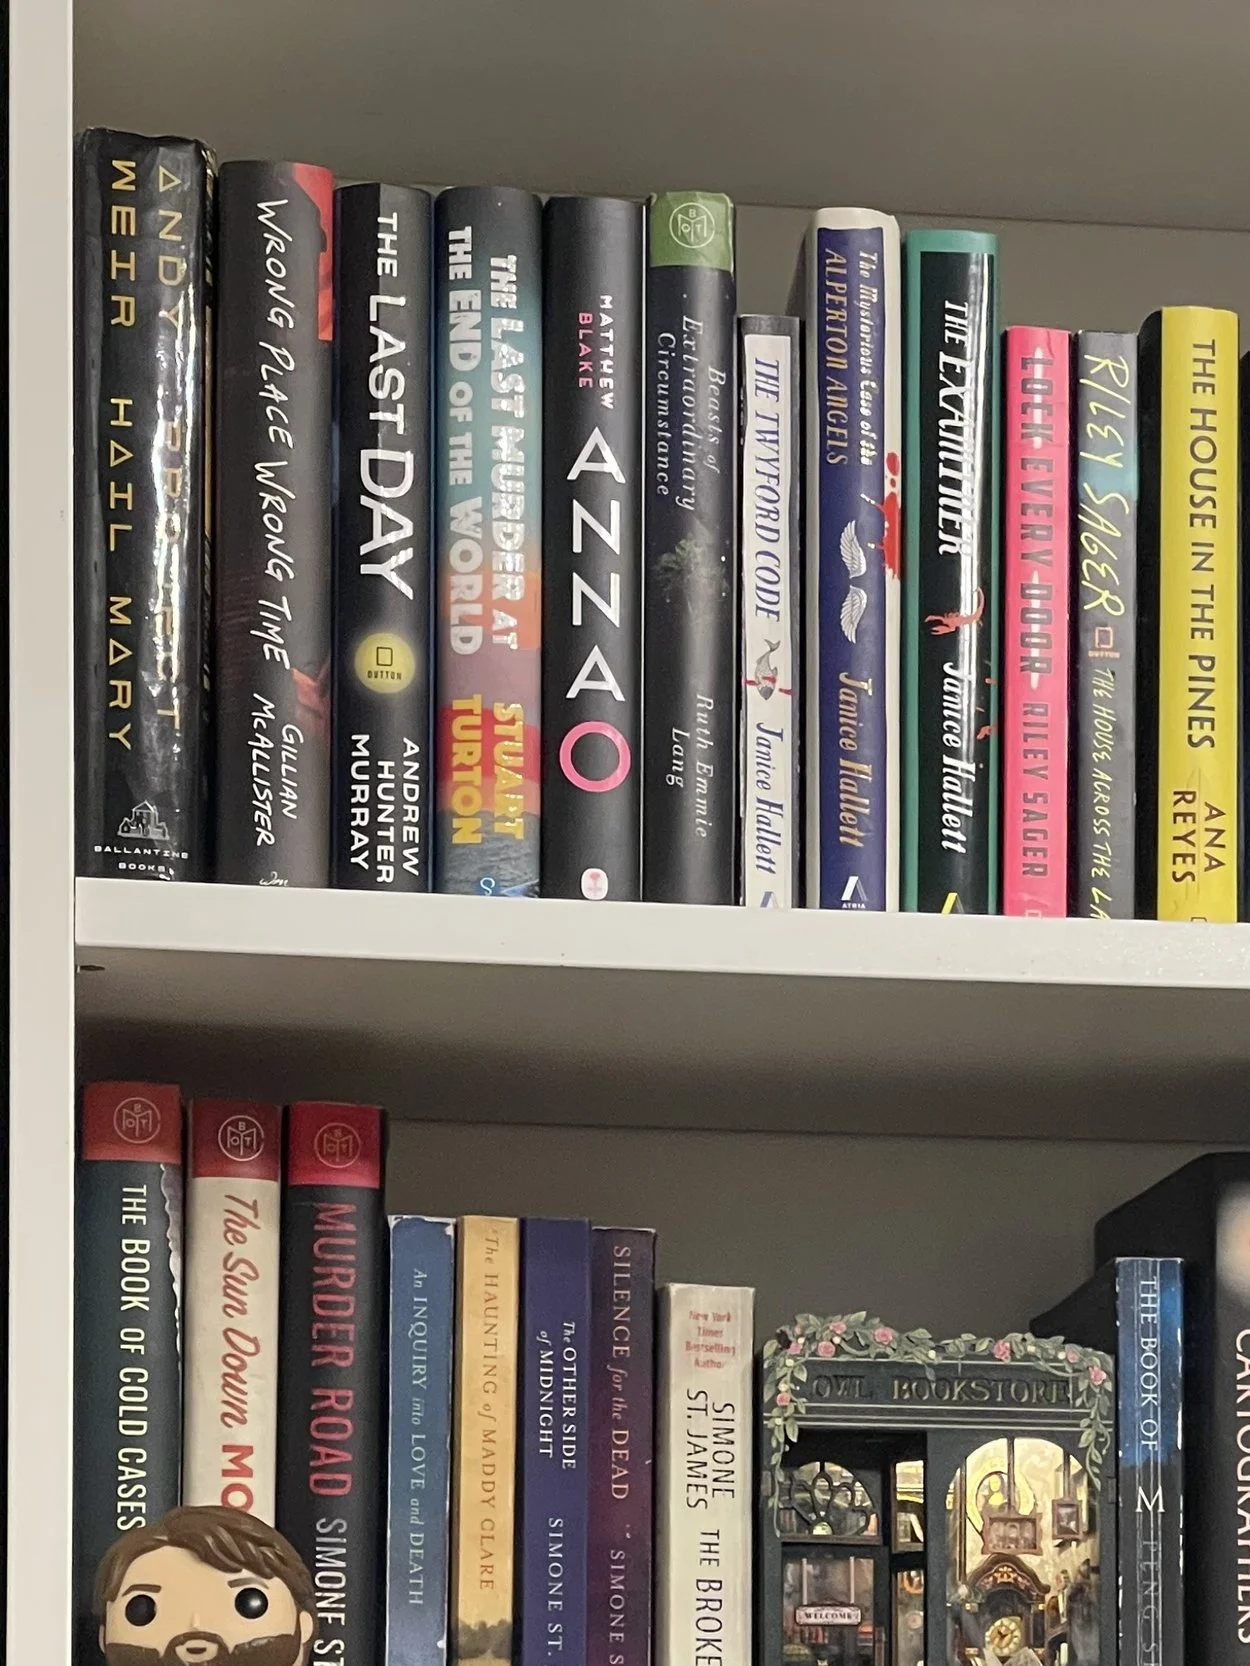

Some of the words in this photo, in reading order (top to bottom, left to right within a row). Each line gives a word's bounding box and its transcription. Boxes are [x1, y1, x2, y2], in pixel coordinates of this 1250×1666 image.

[110, 160, 137, 328] WEIR
[257, 199, 294, 329] WRONG
[377, 212, 397, 276] THE
[257, 342, 294, 449] PLACE
[369, 294, 406, 442] LAST
[657, 331, 676, 495] Circumstance
[676, 315, 703, 511] Extraordinary
[1193, 340, 1215, 395] THE
[110, 397, 134, 551] HAIL
[1190, 408, 1217, 529] HOUSE
[252, 460, 295, 582] WRONG
[359, 447, 413, 601] DAY
[1191, 543, 1214, 572] IN
[251, 592, 291, 669] TIME
[1191, 586, 1214, 641] THE
[109, 596, 132, 752] MARY
[1187, 656, 1216, 748] PINES
[351, 732, 370, 871] MURRAY
[377, 759, 393, 884] HUNTER
[402, 737, 420, 876] ANDREW
[1172, 791, 1196, 883] REYES
[1204, 801, 1226, 873] ANA
[122, 1184, 146, 1226] THE
[222, 1194, 260, 1246] The
[121, 1239, 150, 1311] BOOK
[222, 1251, 260, 1319] Sun
[311, 1203, 357, 1369] MURDER
[121, 1328, 145, 1355] OF
[220, 1328, 260, 1428] Down
[118, 1367, 148, 1437] COLD
[687, 1389, 708, 1421] ST.
[811, 1374, 871, 1401] OWL
[892, 1374, 1074, 1403] BOOKSTORE
[309, 1387, 353, 1498] ROAD
[687, 1429, 708, 1510] JAMES
[711, 1402, 735, 1499] SIMONE
[700, 1529, 720, 1567] THE
[803, 1611, 853, 1622] WELCOME
